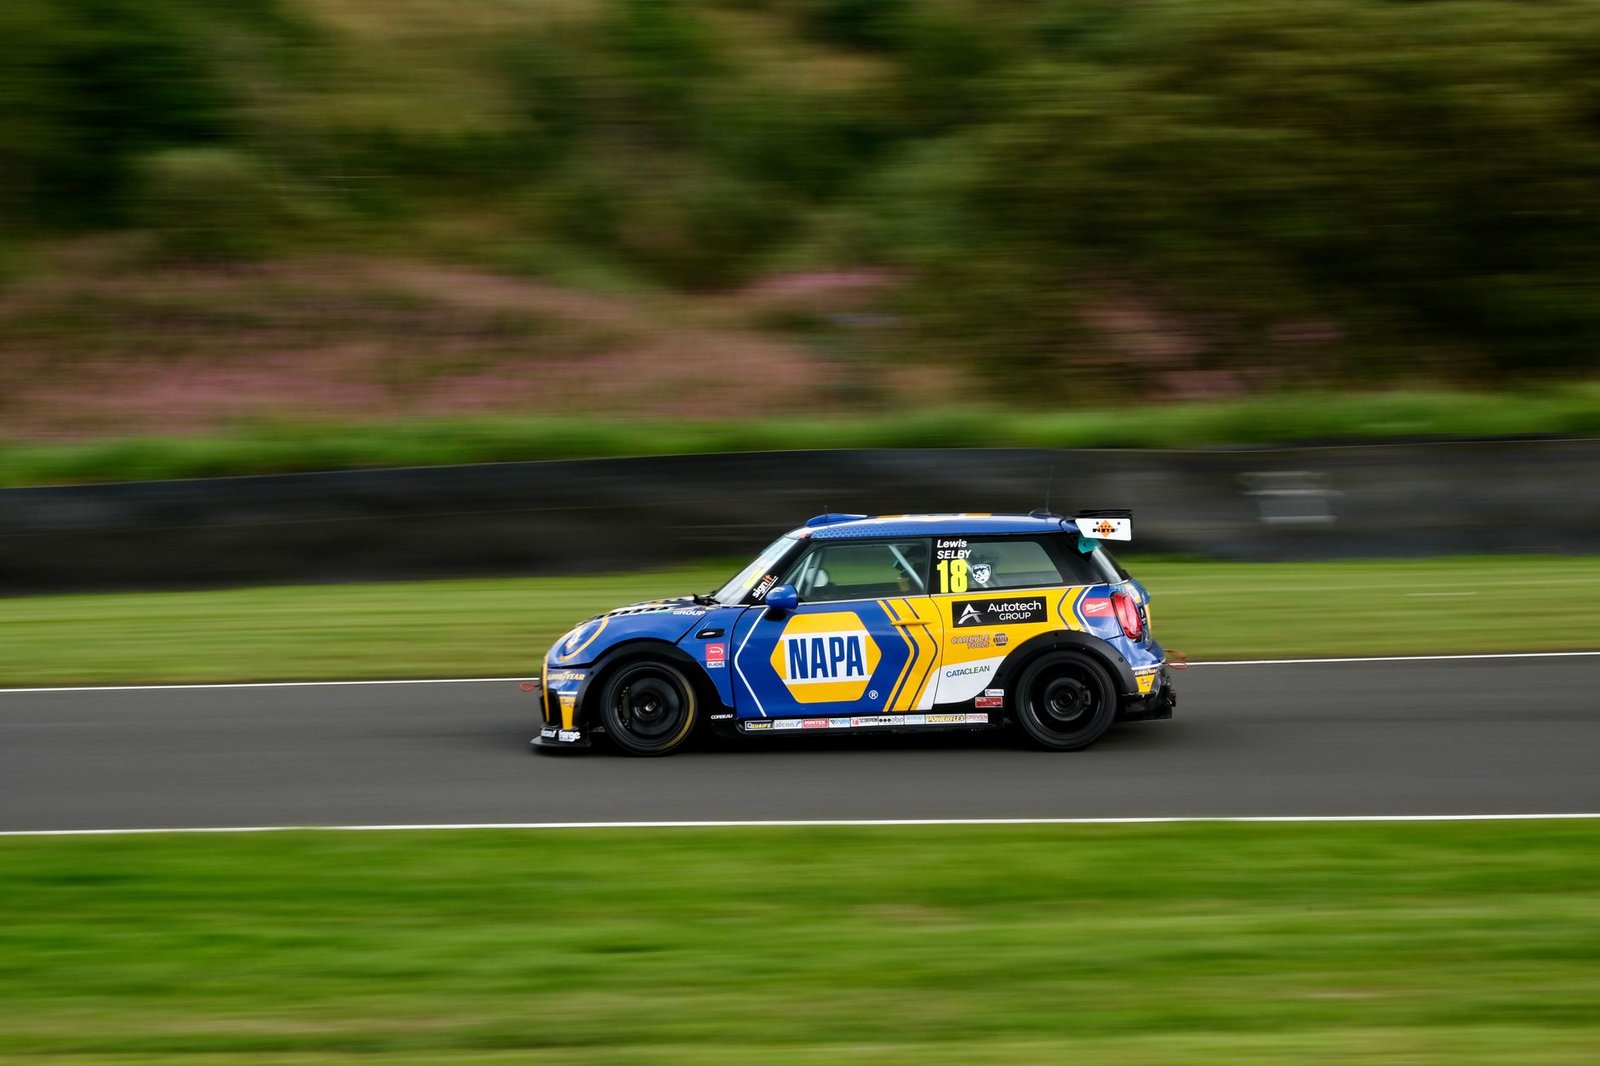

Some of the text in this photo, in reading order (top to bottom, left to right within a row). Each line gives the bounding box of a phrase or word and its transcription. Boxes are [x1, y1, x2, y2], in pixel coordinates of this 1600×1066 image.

[937, 539, 967, 548] Lewis
[937, 550, 971, 559] SELBY
[937, 559, 968, 593] 18
[987, 600, 1042, 613] Autotech
[999, 612, 1031, 621] GROUP
[788, 636, 864, 680] NAPA
[946, 665, 990, 678] CATACLEAN
